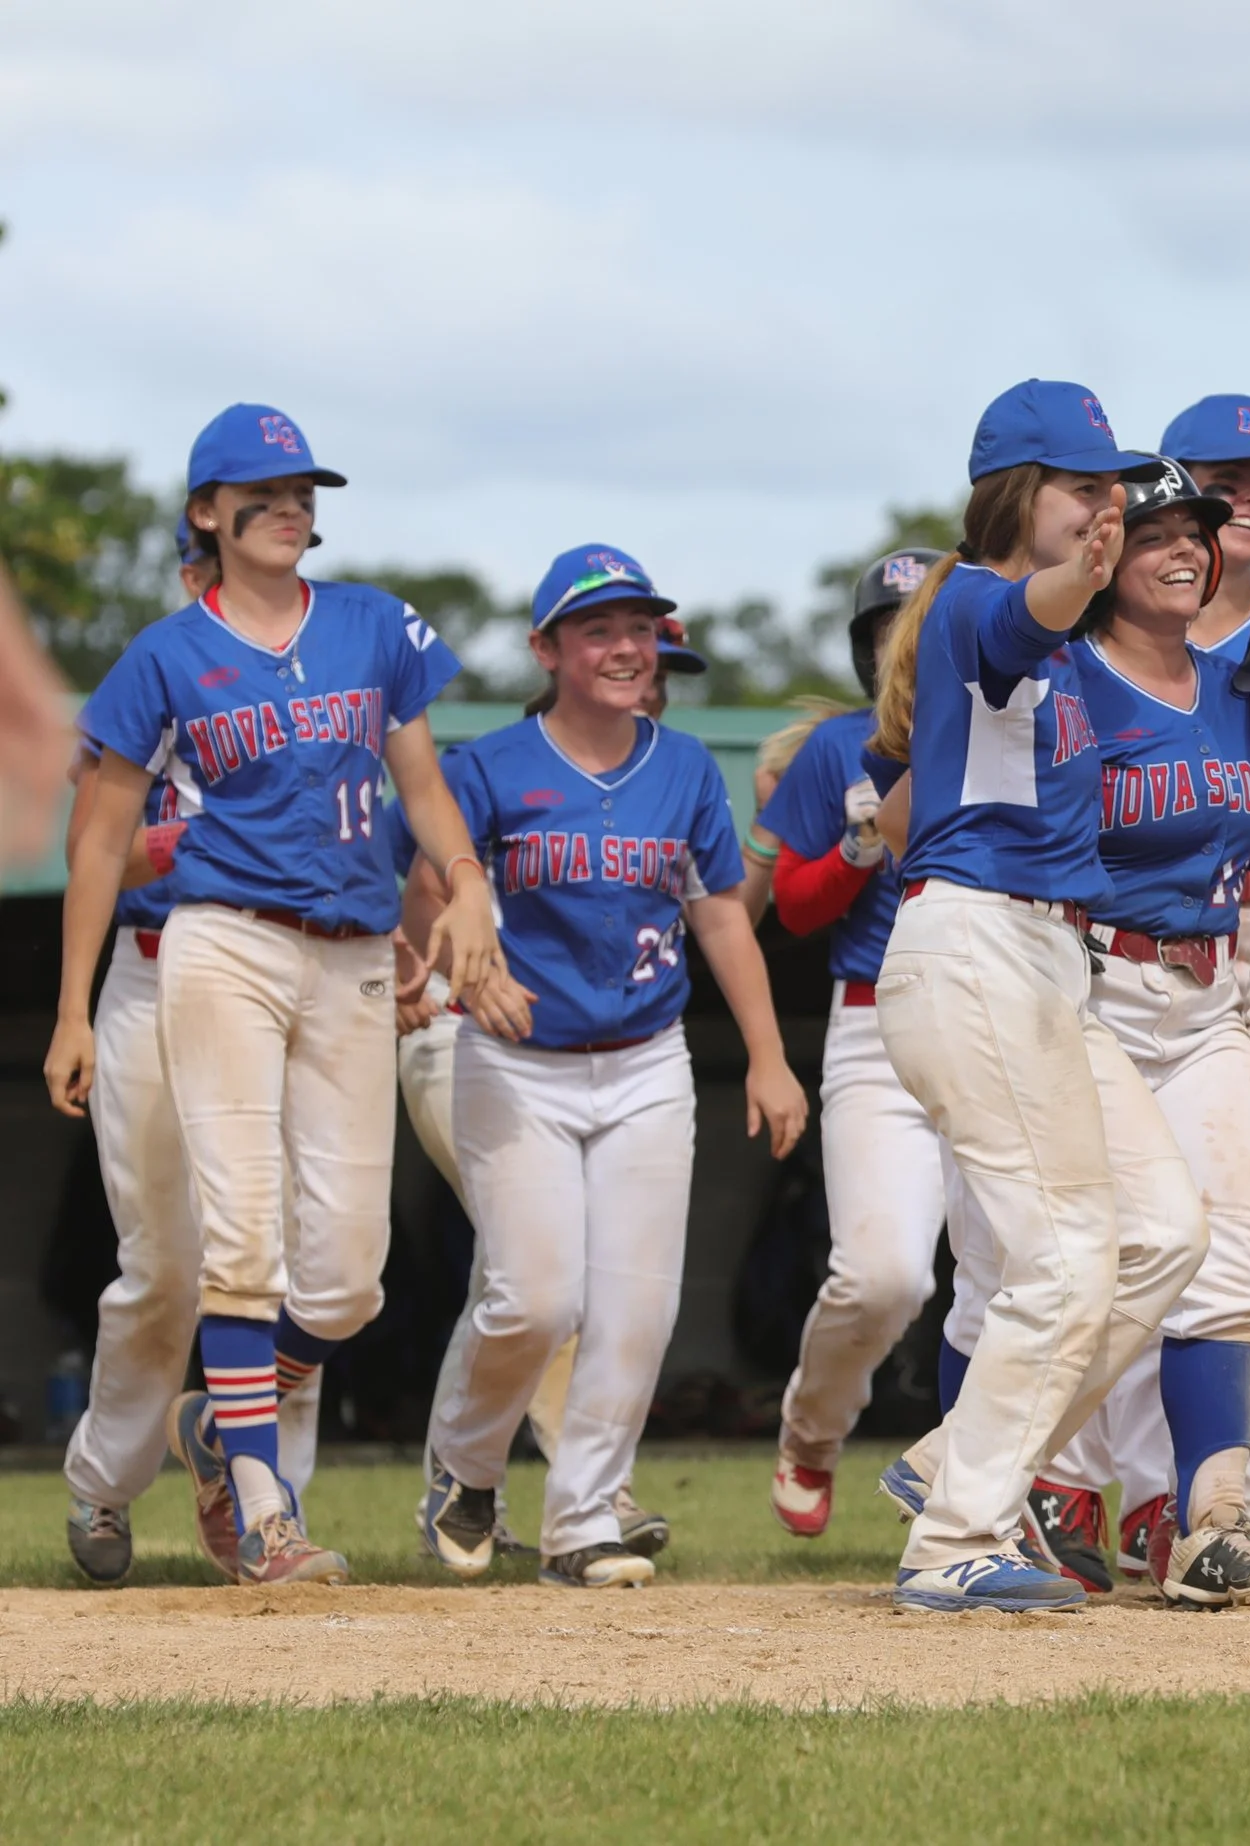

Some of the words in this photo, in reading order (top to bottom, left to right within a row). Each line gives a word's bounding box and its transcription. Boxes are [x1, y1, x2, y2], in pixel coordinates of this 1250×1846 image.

[1082, 398, 1114, 441] N
[186, 702, 287, 786] NOVA
[1099, 761, 1197, 832] NOVA
[502, 831, 592, 896] NOVA
[601, 834, 688, 901] SCOT
